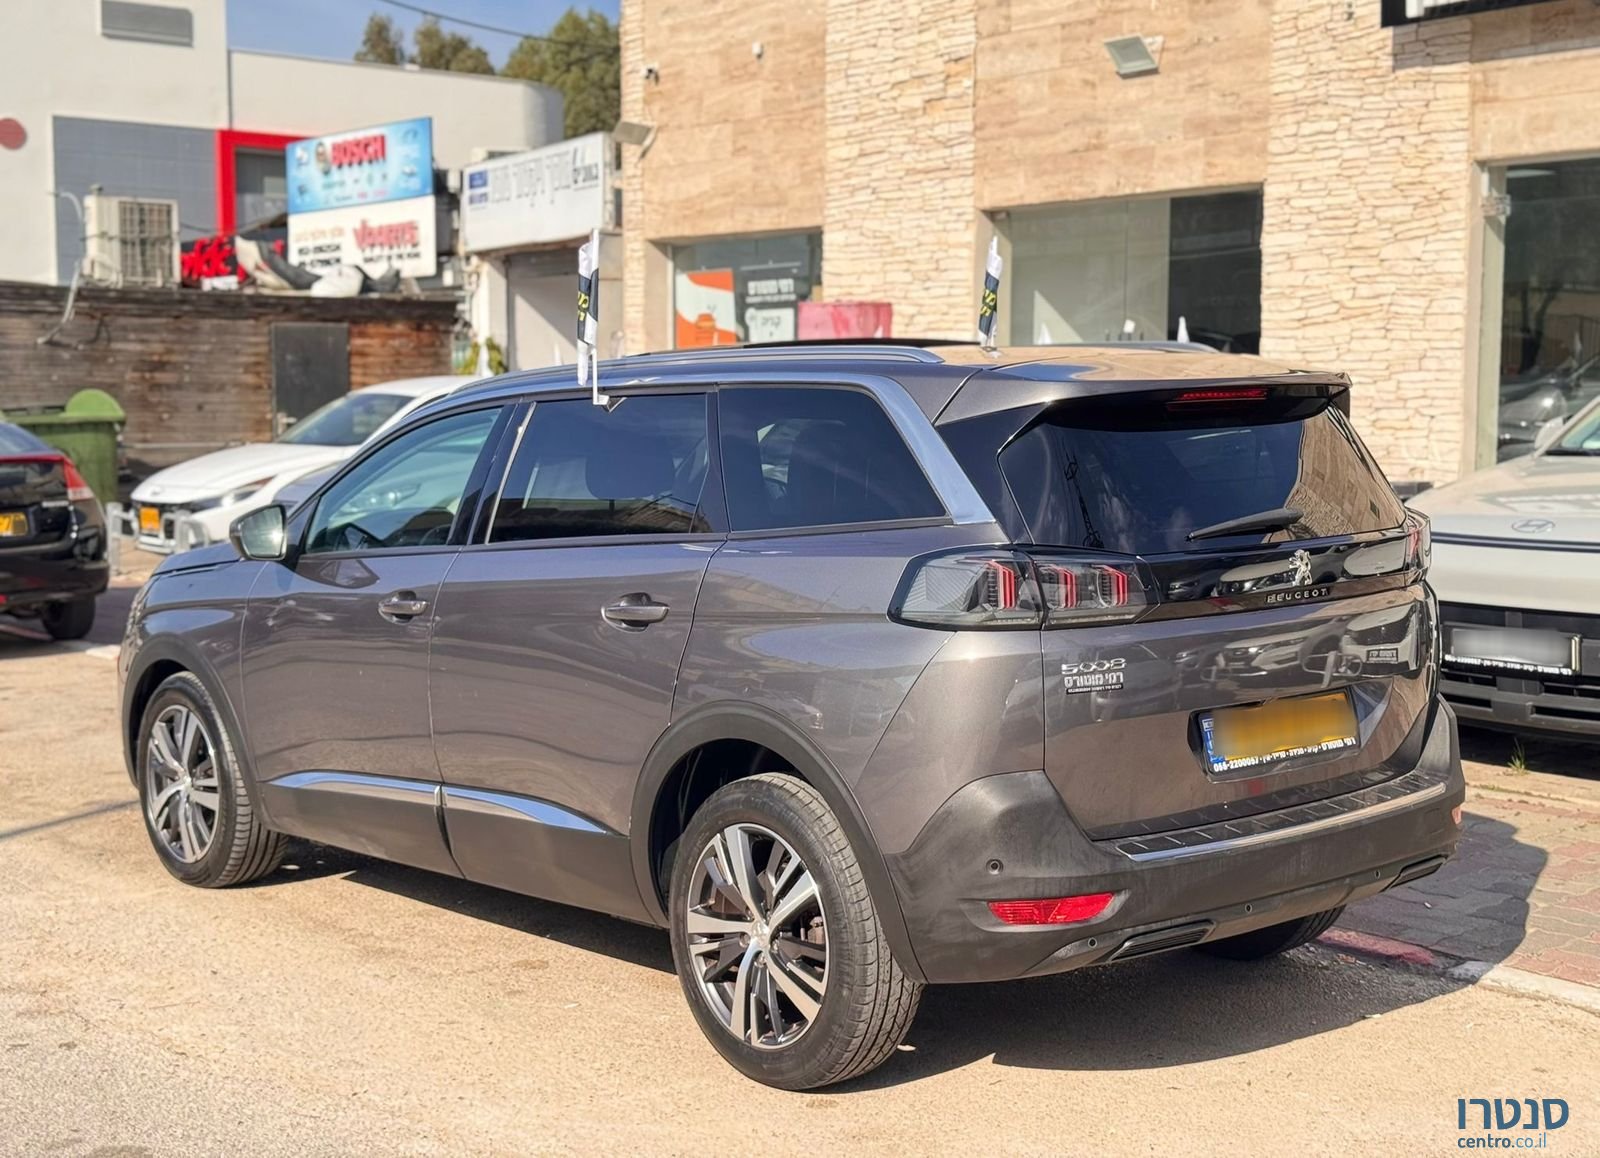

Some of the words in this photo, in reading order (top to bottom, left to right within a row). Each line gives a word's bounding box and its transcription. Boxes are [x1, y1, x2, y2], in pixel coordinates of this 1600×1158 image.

[331, 135, 386, 168] BOSCH
[1267, 588, 1328, 603] PEUGEOT
[1061, 657, 1127, 675] 5008
[1064, 674, 1104, 688] מוטורס
[1104, 671, 1124, 685] רמי
